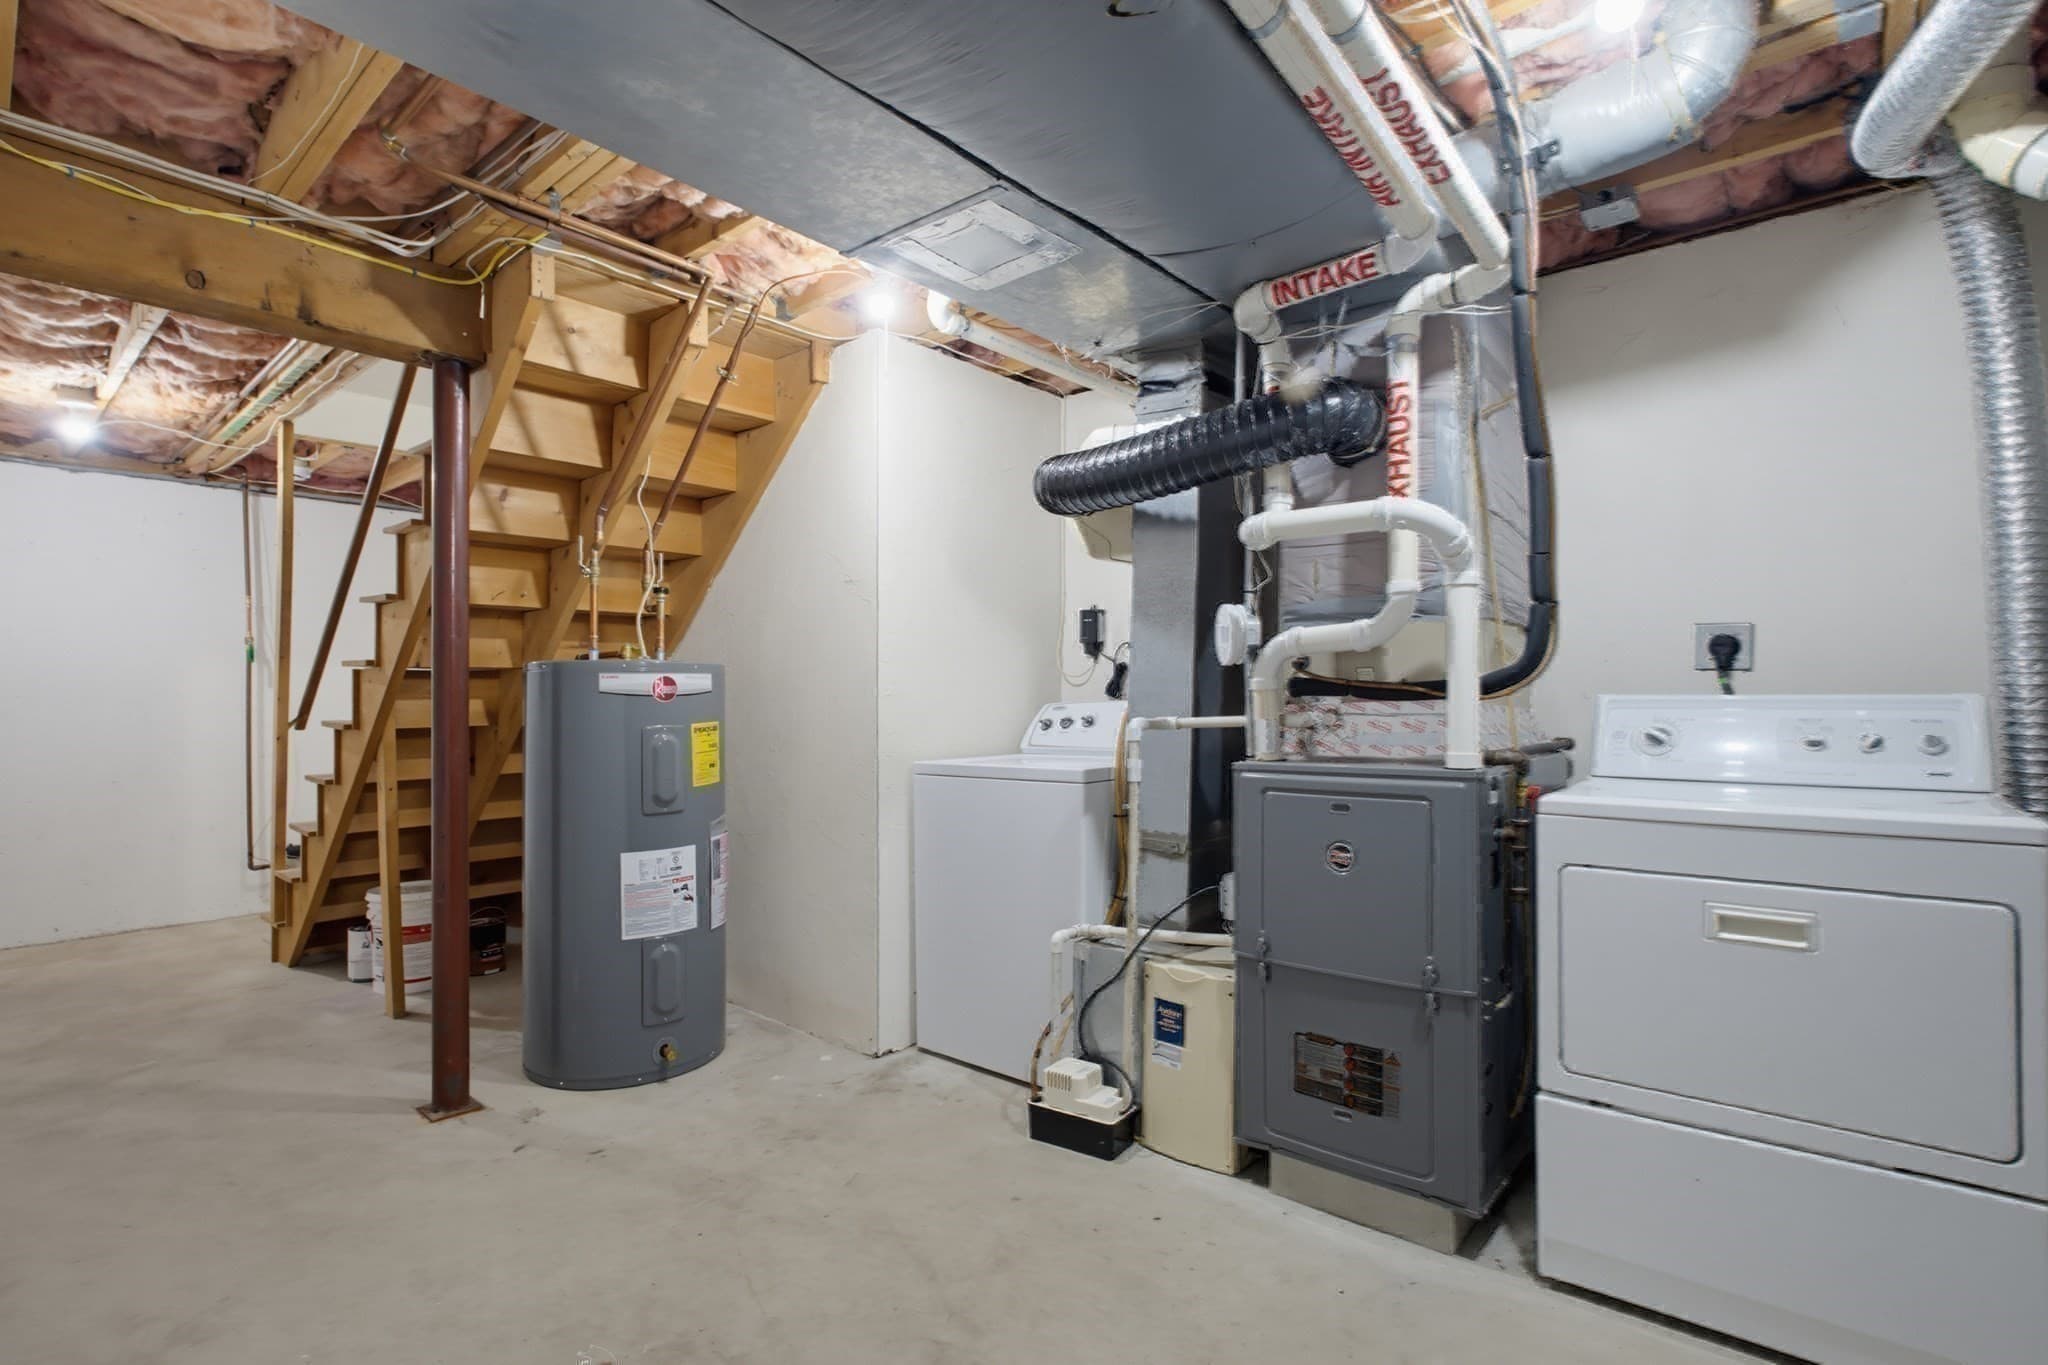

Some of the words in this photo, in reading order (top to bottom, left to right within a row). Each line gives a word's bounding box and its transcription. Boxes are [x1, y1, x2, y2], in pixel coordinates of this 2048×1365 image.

[1302, 86, 1375, 171] INTAKE
[1358, 66, 1450, 185] EXHAUST
[1270, 251, 1378, 306] INTAKE
[1386, 380, 1412, 498] XHAUST
